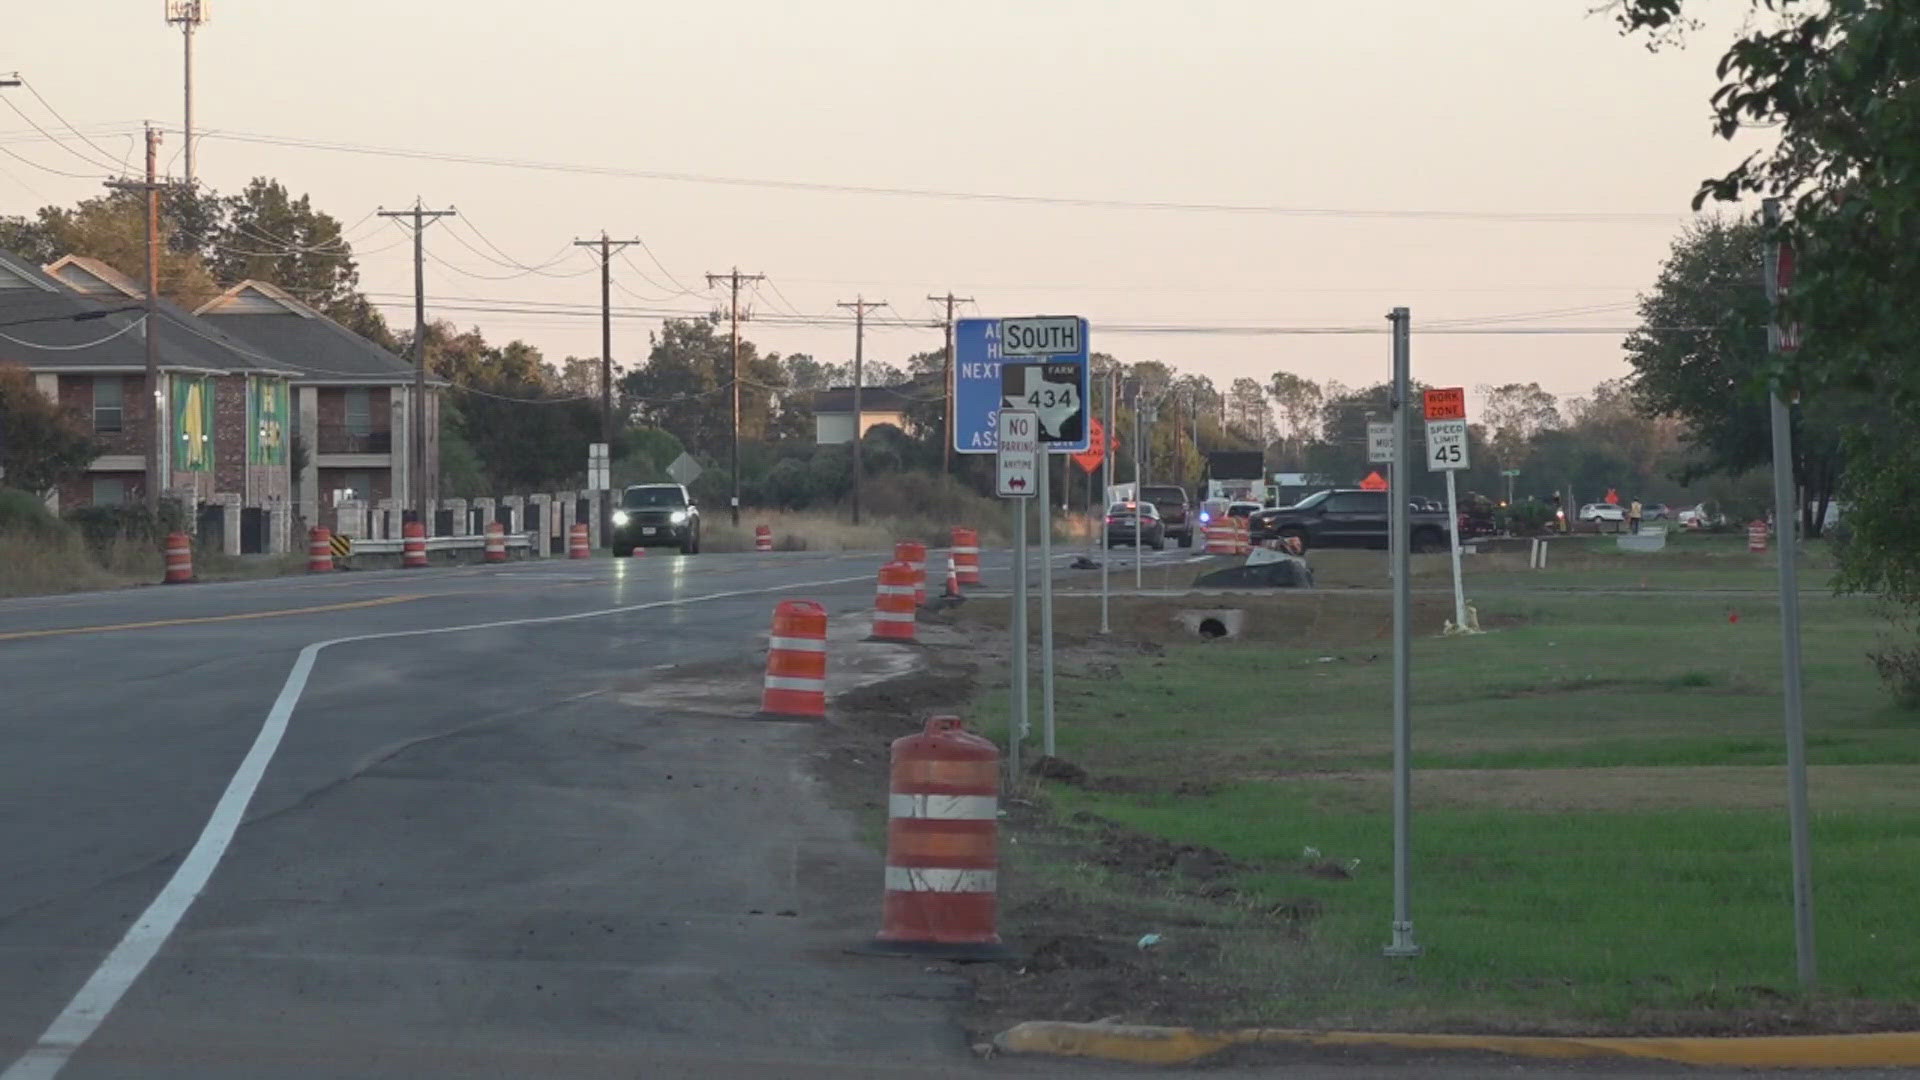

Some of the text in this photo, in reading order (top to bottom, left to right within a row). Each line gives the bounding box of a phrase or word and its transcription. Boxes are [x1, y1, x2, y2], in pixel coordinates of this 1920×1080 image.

[1007, 325, 1074, 349] SOUTH
[962, 363, 1001, 379] NEXT
[1048, 366, 1075, 376] FARM
[1028, 390, 1071, 408] 434
[1429, 392, 1459, 403] WORK
[1430, 404, 1459, 417] ZONE
[1009, 419, 1029, 436] NO
[1430, 425, 1463, 435] SPEED
[1433, 435, 1459, 445] LIMIT
[1001, 441, 1035, 453] PARKING
[1435, 444, 1462, 464] 45
[1003, 460, 1033, 470] ANYTIME
